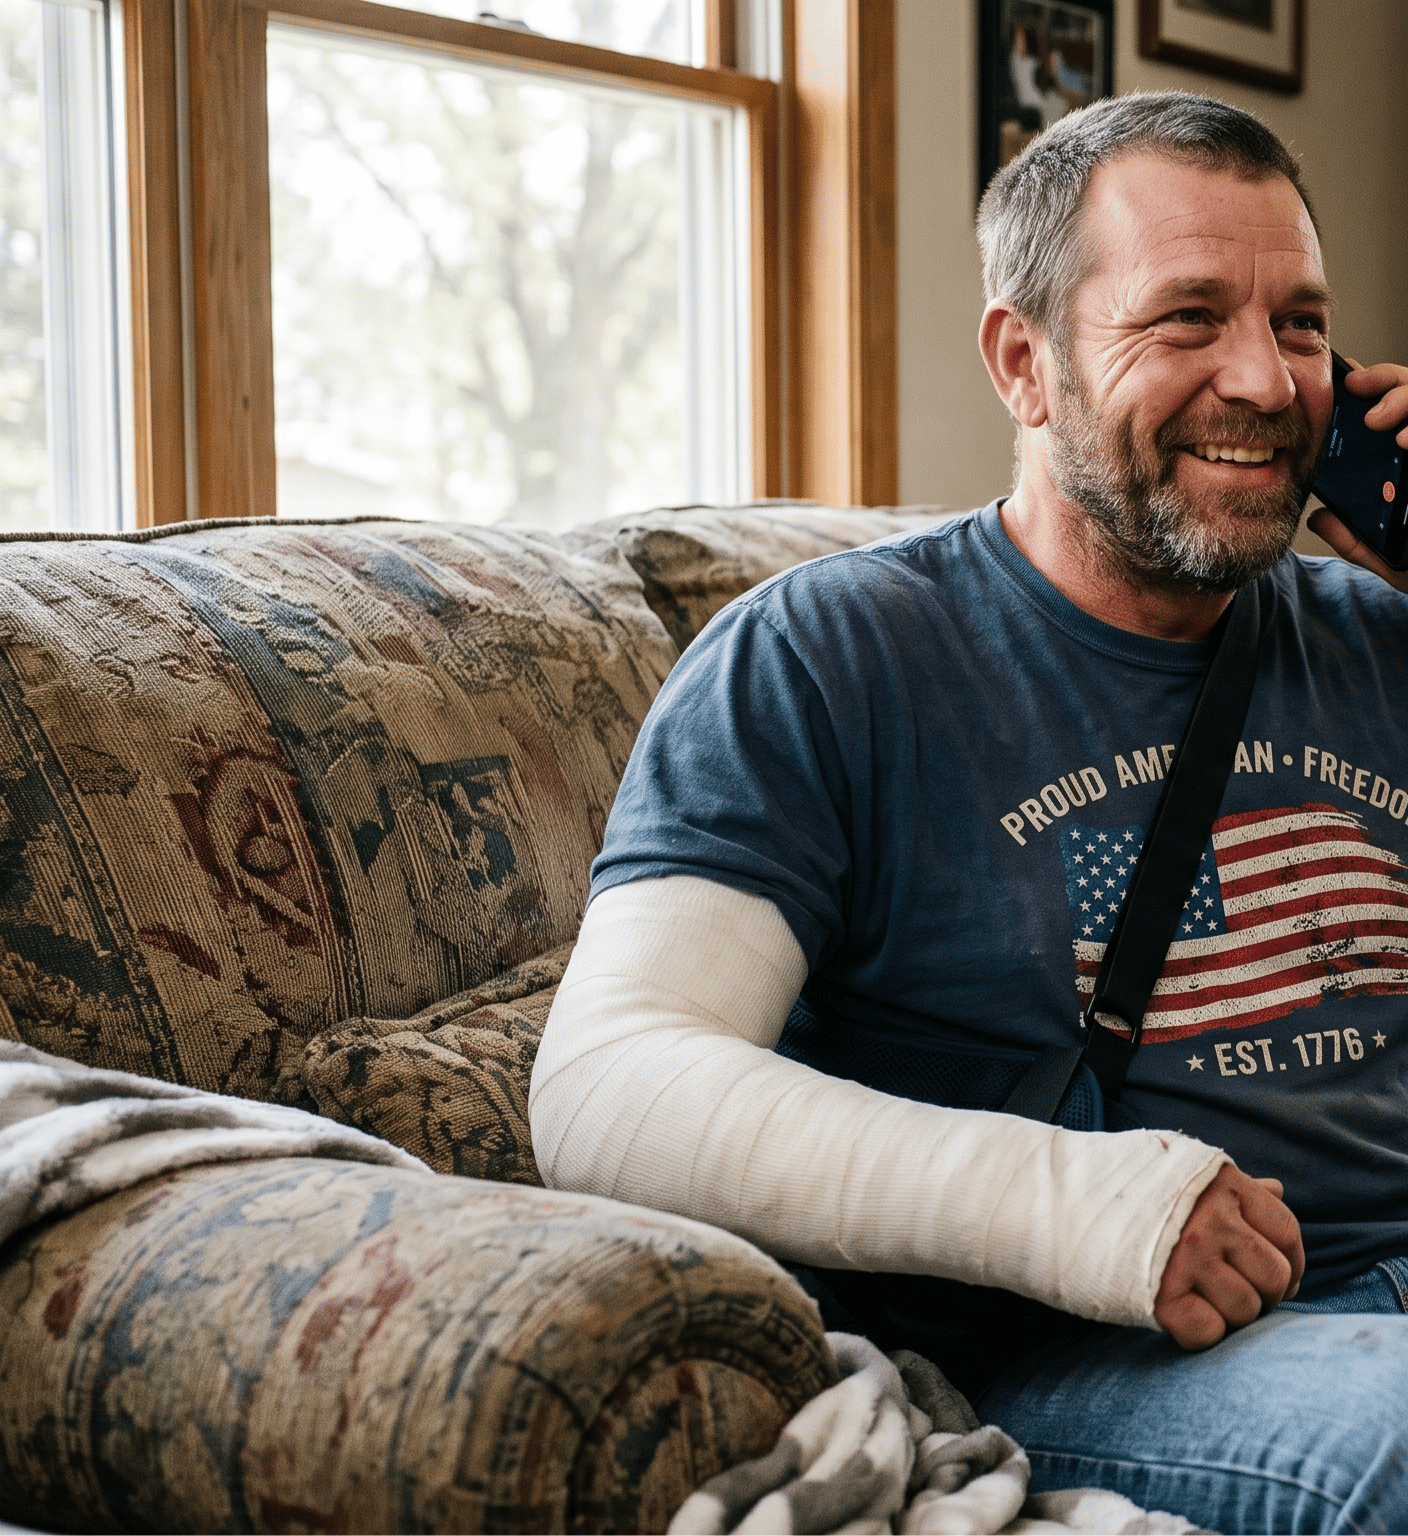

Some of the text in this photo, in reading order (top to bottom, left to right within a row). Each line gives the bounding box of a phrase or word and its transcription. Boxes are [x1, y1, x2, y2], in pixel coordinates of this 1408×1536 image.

[1000, 766, 1107, 846] PROUD
[1114, 741, 1274, 788] AMEAN
[1214, 1027, 1364, 1077] EST. 1776
